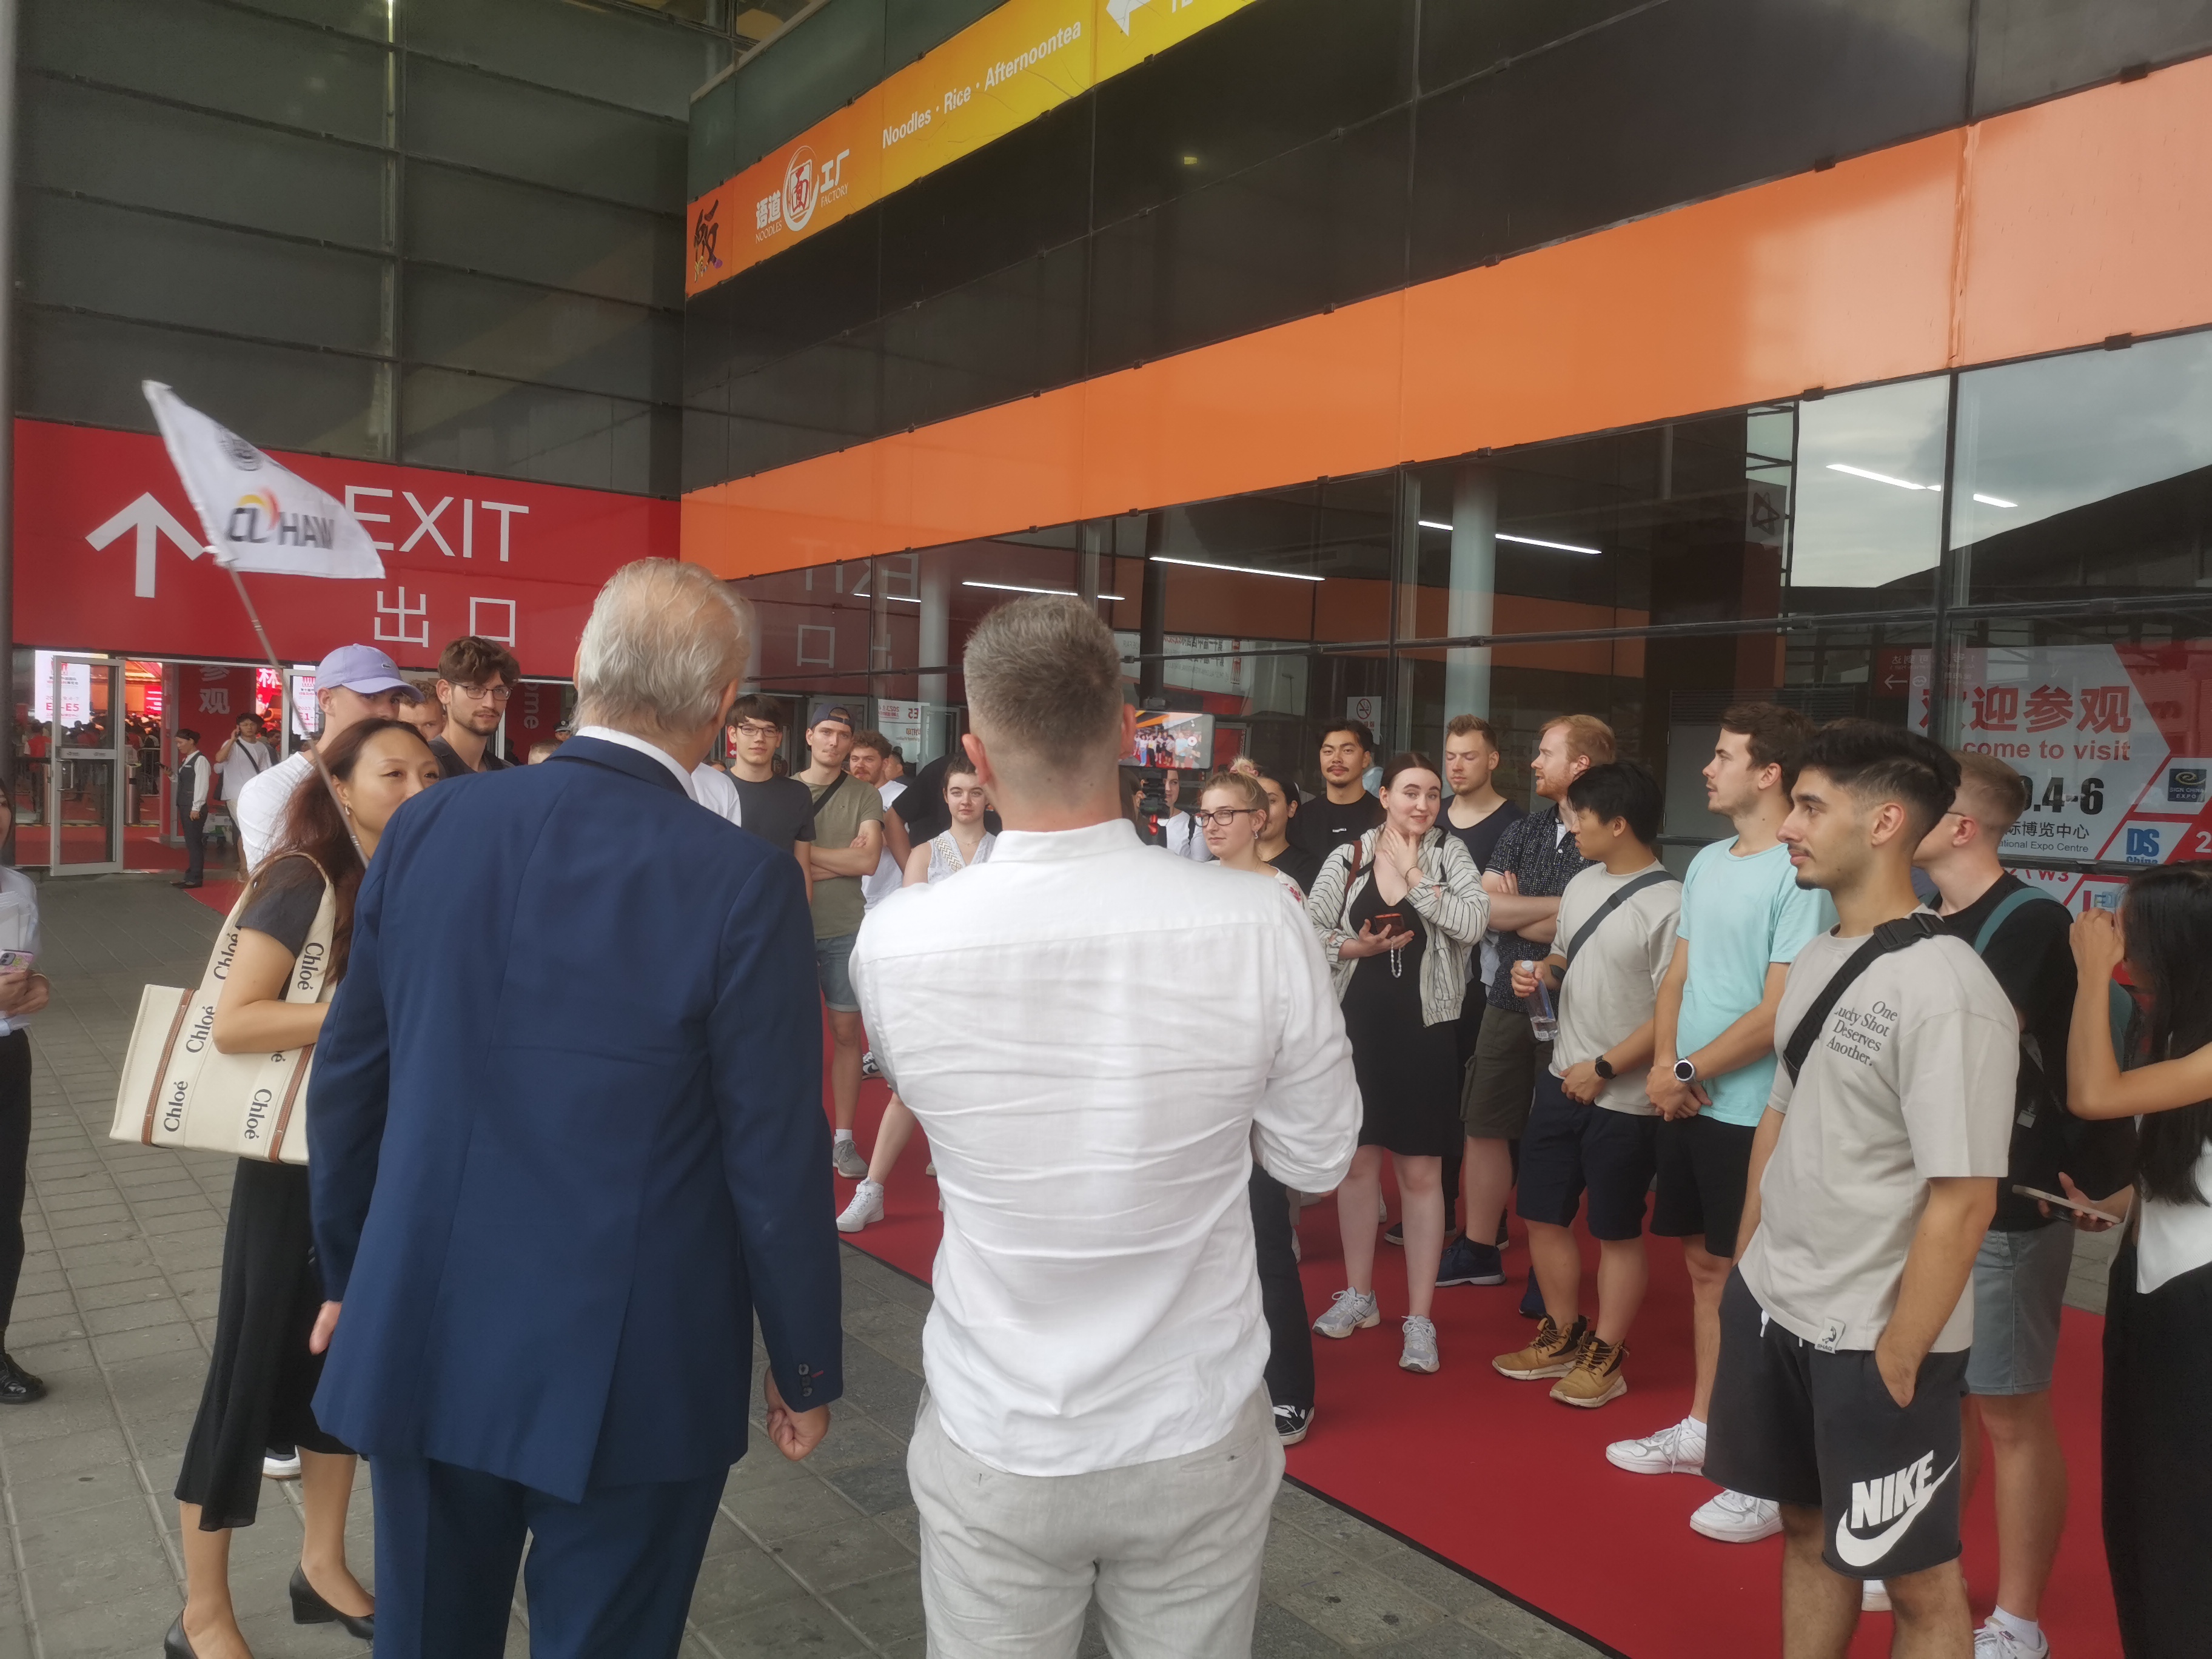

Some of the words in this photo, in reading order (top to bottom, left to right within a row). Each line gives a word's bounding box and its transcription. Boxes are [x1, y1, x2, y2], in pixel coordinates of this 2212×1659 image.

[882, 107, 931, 149] Noodles
[944, 86, 971, 114] Rice
[984, 21, 1081, 91] Afternoontea
[756, 220, 782, 244] NOODLES
[821, 183, 849, 207] FACTORY
[345, 486, 529, 562] EXIT
[374, 586, 516, 648] 出口
[1963, 742, 2031, 759] come
[2040, 740, 2064, 760] to
[2074, 740, 2131, 761] visit
[2031, 841, 2054, 851] Expo
[2057, 843, 2089, 853] Centre
[2126, 828, 2160, 857] DS
[297, 942, 325, 991] Chloé
[186, 1005, 215, 1053] Chloé
[1832, 1019, 1882, 1051] Deserves
[1860, 1013, 1890, 1037] Shot
[1872, 1001, 1898, 1022] One
[1826, 1035, 1872, 1066] Another.
[163, 1081, 189, 1132] Chloé
[244, 1088, 272, 1140] Chloé
[1851, 1450, 1934, 1529] NIKE
